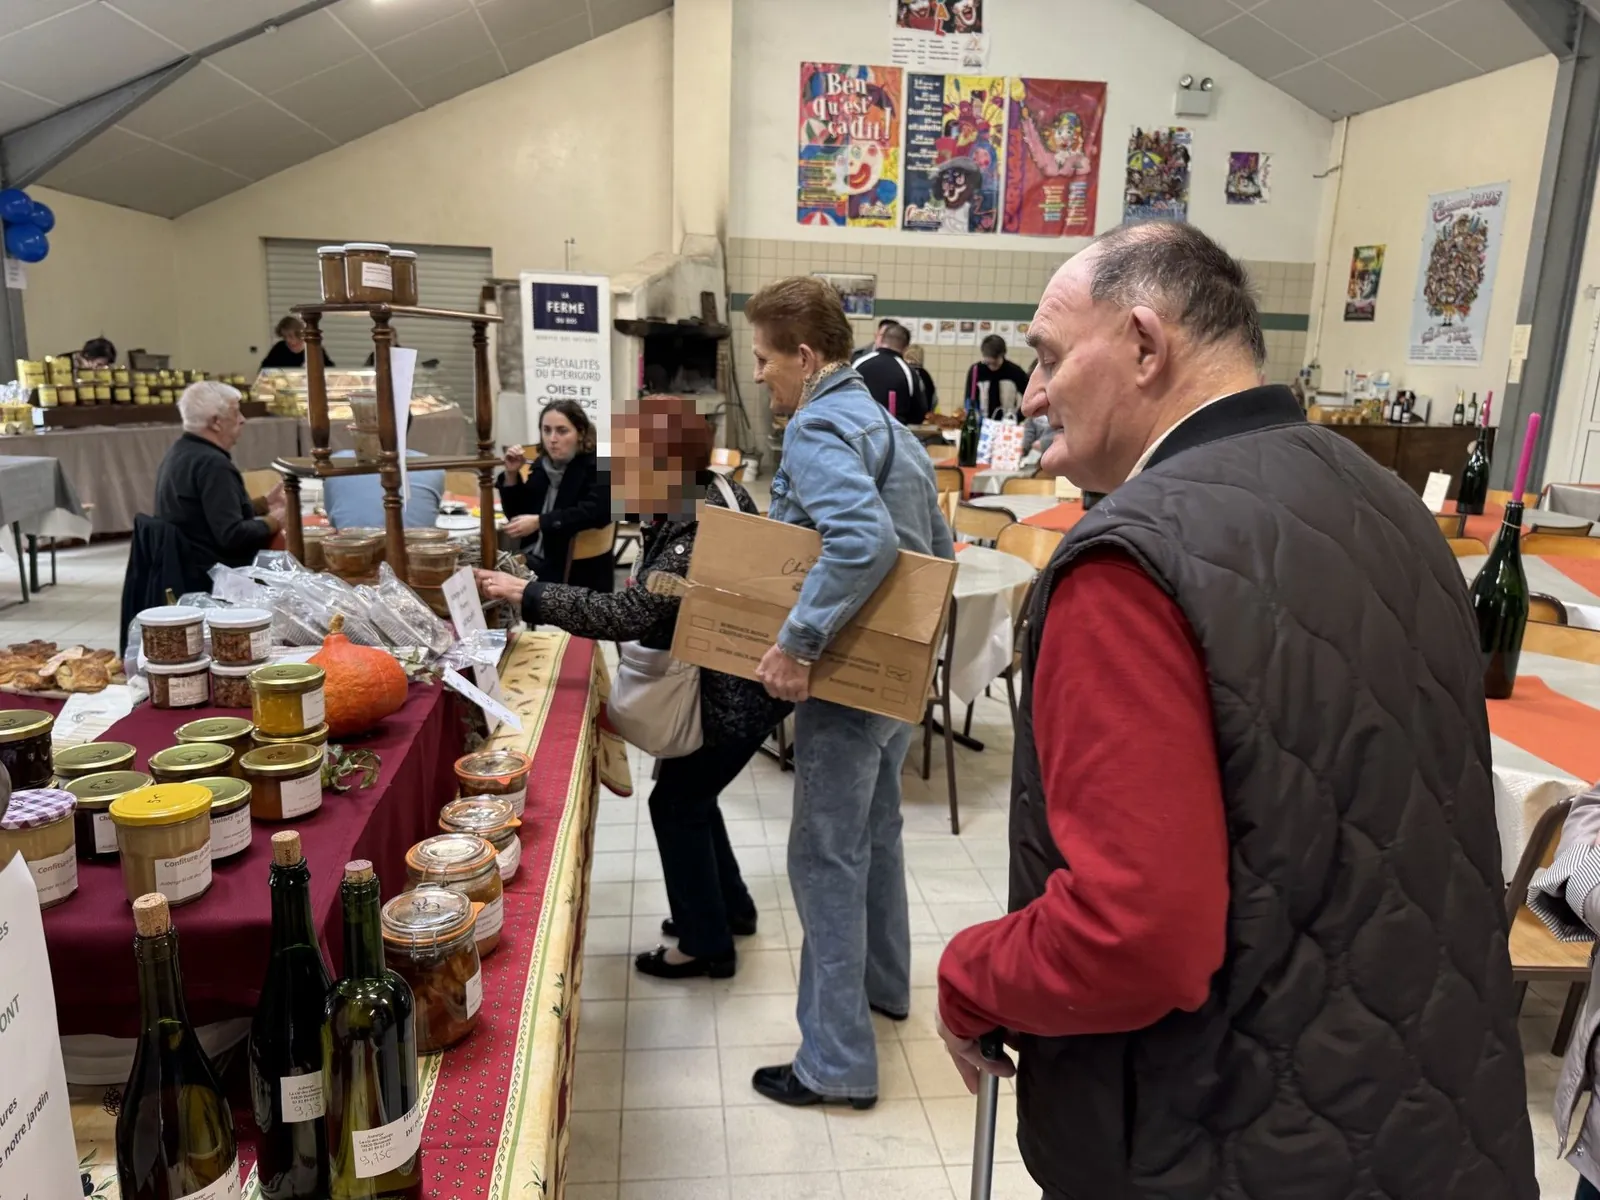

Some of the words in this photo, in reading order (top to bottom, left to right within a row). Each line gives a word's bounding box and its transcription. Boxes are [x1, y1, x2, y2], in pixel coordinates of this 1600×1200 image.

[827, 73, 867, 95] Ben
[546, 300, 585, 315] FERME
[536, 369, 549, 379] DU
[546, 384, 578, 396] OIES
[163, 854, 199, 868] Confiture
[0, 1097, 18, 1129] ures
[4, 1123, 27, 1161] notre
[26, 1090, 50, 1130] jardin
